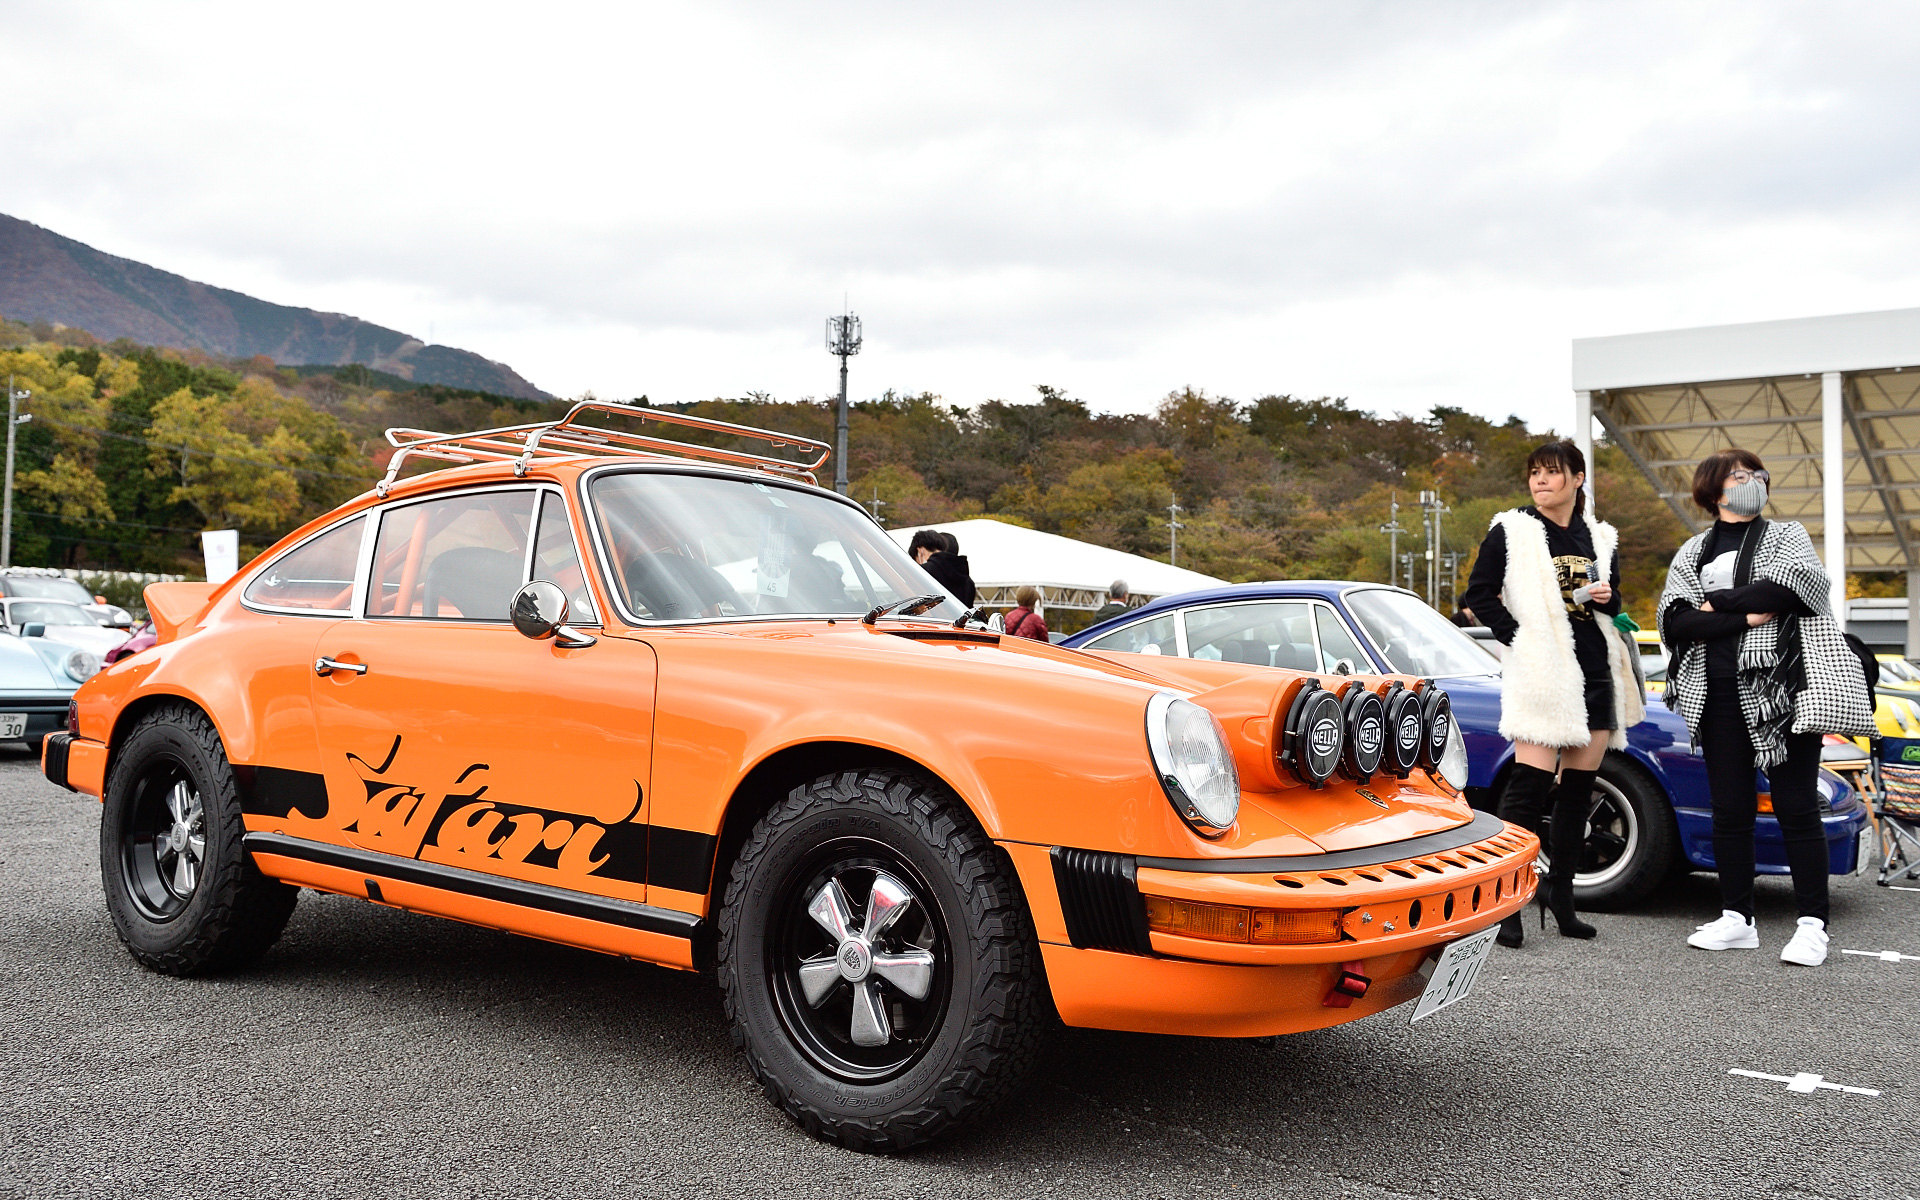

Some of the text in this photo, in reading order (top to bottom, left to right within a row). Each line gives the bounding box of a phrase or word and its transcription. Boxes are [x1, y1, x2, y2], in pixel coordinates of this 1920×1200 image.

[766, 582, 777, 593] 45
[4, 723, 22, 736] 30
[1313, 728, 1338, 745] HELLA
[1360, 727, 1381, 744] HELLA
[1400, 723, 1419, 740] HELLA
[1433, 722, 1448, 737] HELLA
[287, 734, 643, 876] Safari
[847, 814, 881, 832] T/A
[832, 1042, 949, 1110] BFGoodrich
[808, 1087, 830, 1103] Baja
